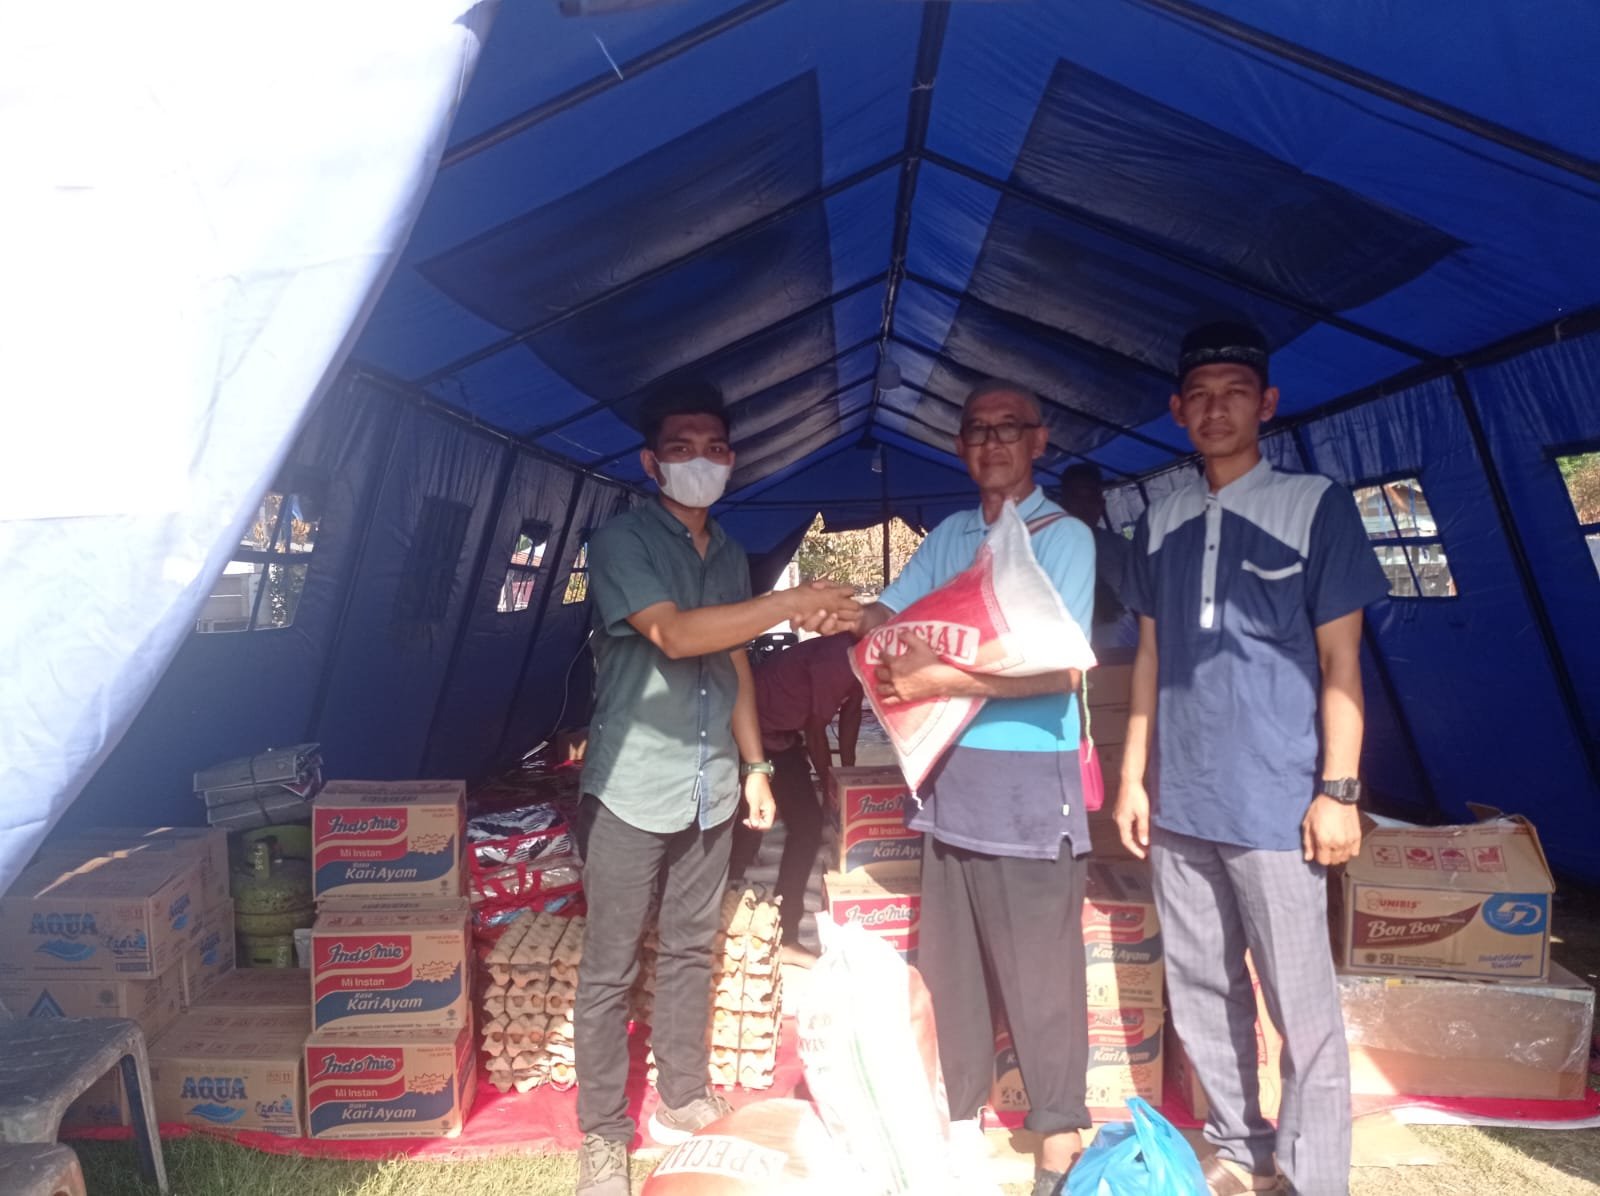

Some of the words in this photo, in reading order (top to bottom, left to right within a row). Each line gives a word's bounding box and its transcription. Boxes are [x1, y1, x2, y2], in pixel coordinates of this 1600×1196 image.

[873, 845, 899, 858] Kari
[345, 867, 376, 879] Kari
[376, 868, 417, 881] Ayam
[28, 912, 98, 940] AQUA
[1367, 920, 1407, 938] Bon
[1408, 921, 1441, 935] Bon
[346, 997, 380, 1011] Kari
[380, 998, 423, 1013] Ayam
[180, 1076, 248, 1104] AQUA
[341, 1107, 373, 1120] Kari
[374, 1108, 417, 1122] Ayam
